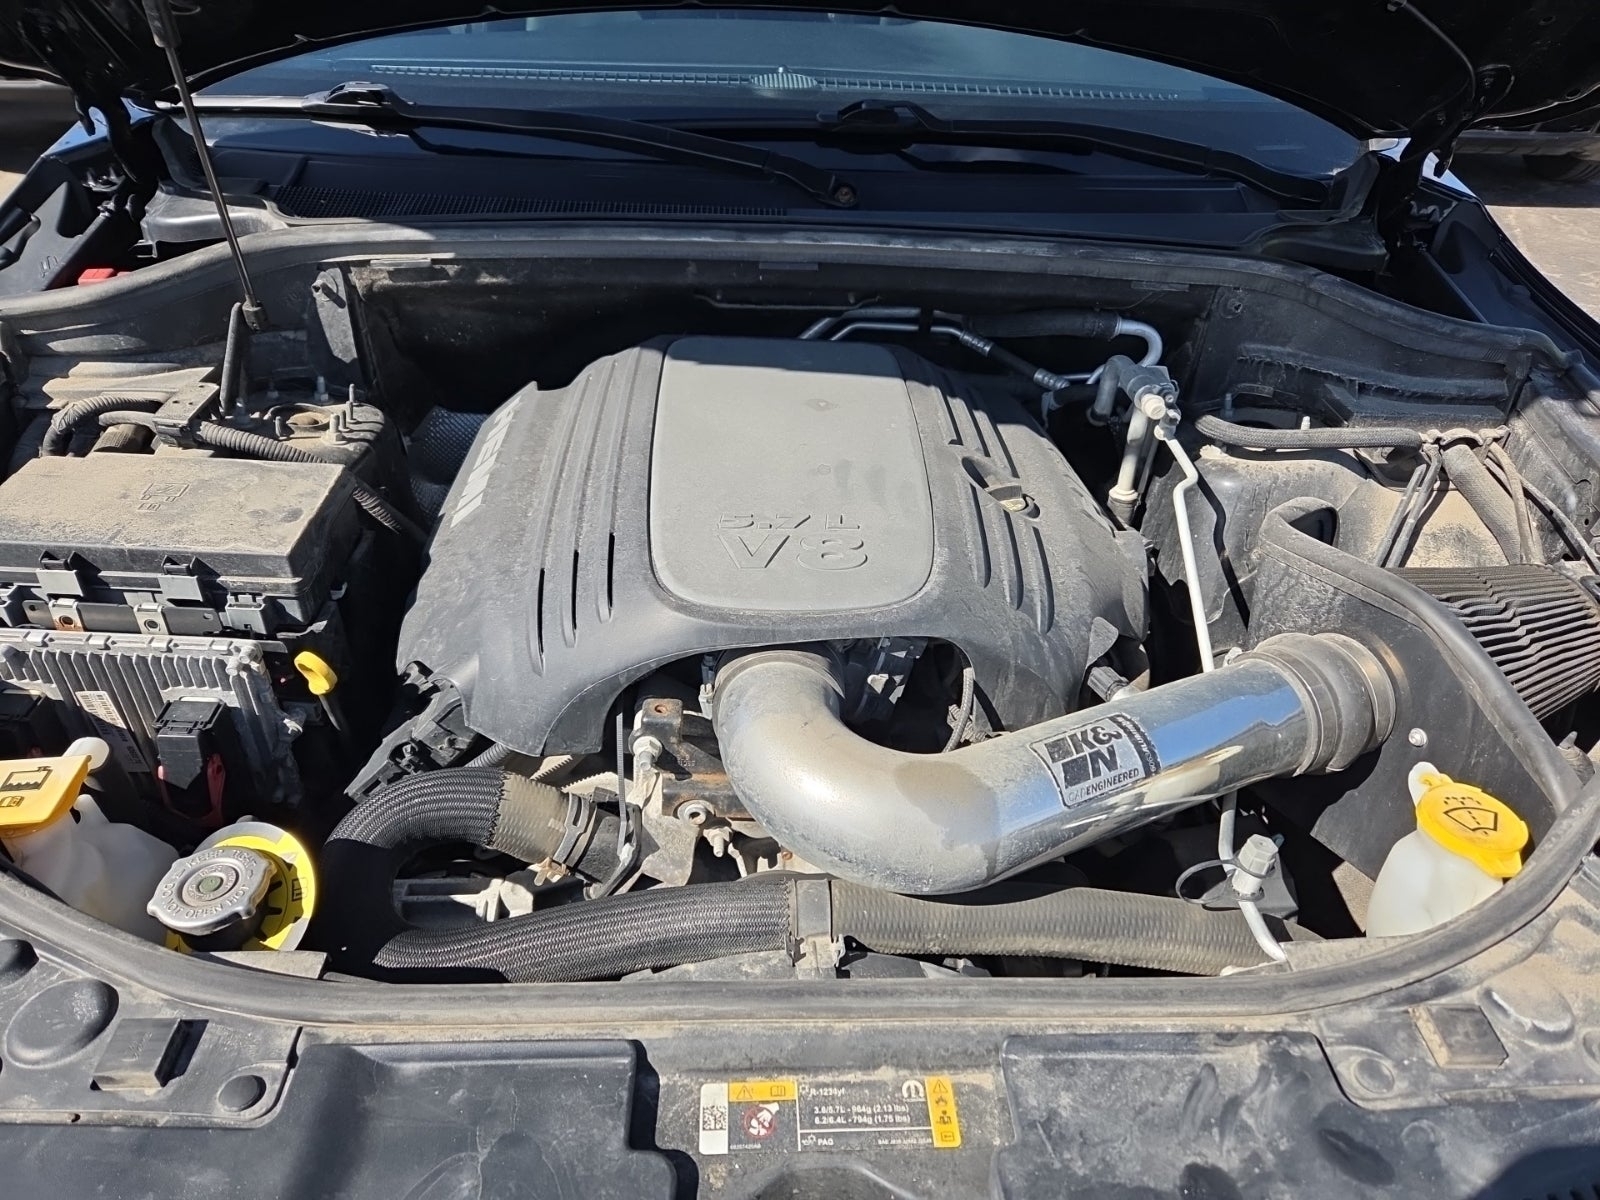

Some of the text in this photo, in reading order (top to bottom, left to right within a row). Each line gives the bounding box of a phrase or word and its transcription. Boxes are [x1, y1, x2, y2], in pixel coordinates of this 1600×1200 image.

[450, 395, 521, 528] HEMI
[716, 532, 868, 571] V8
[818, 1138, 834, 1146] PAG
